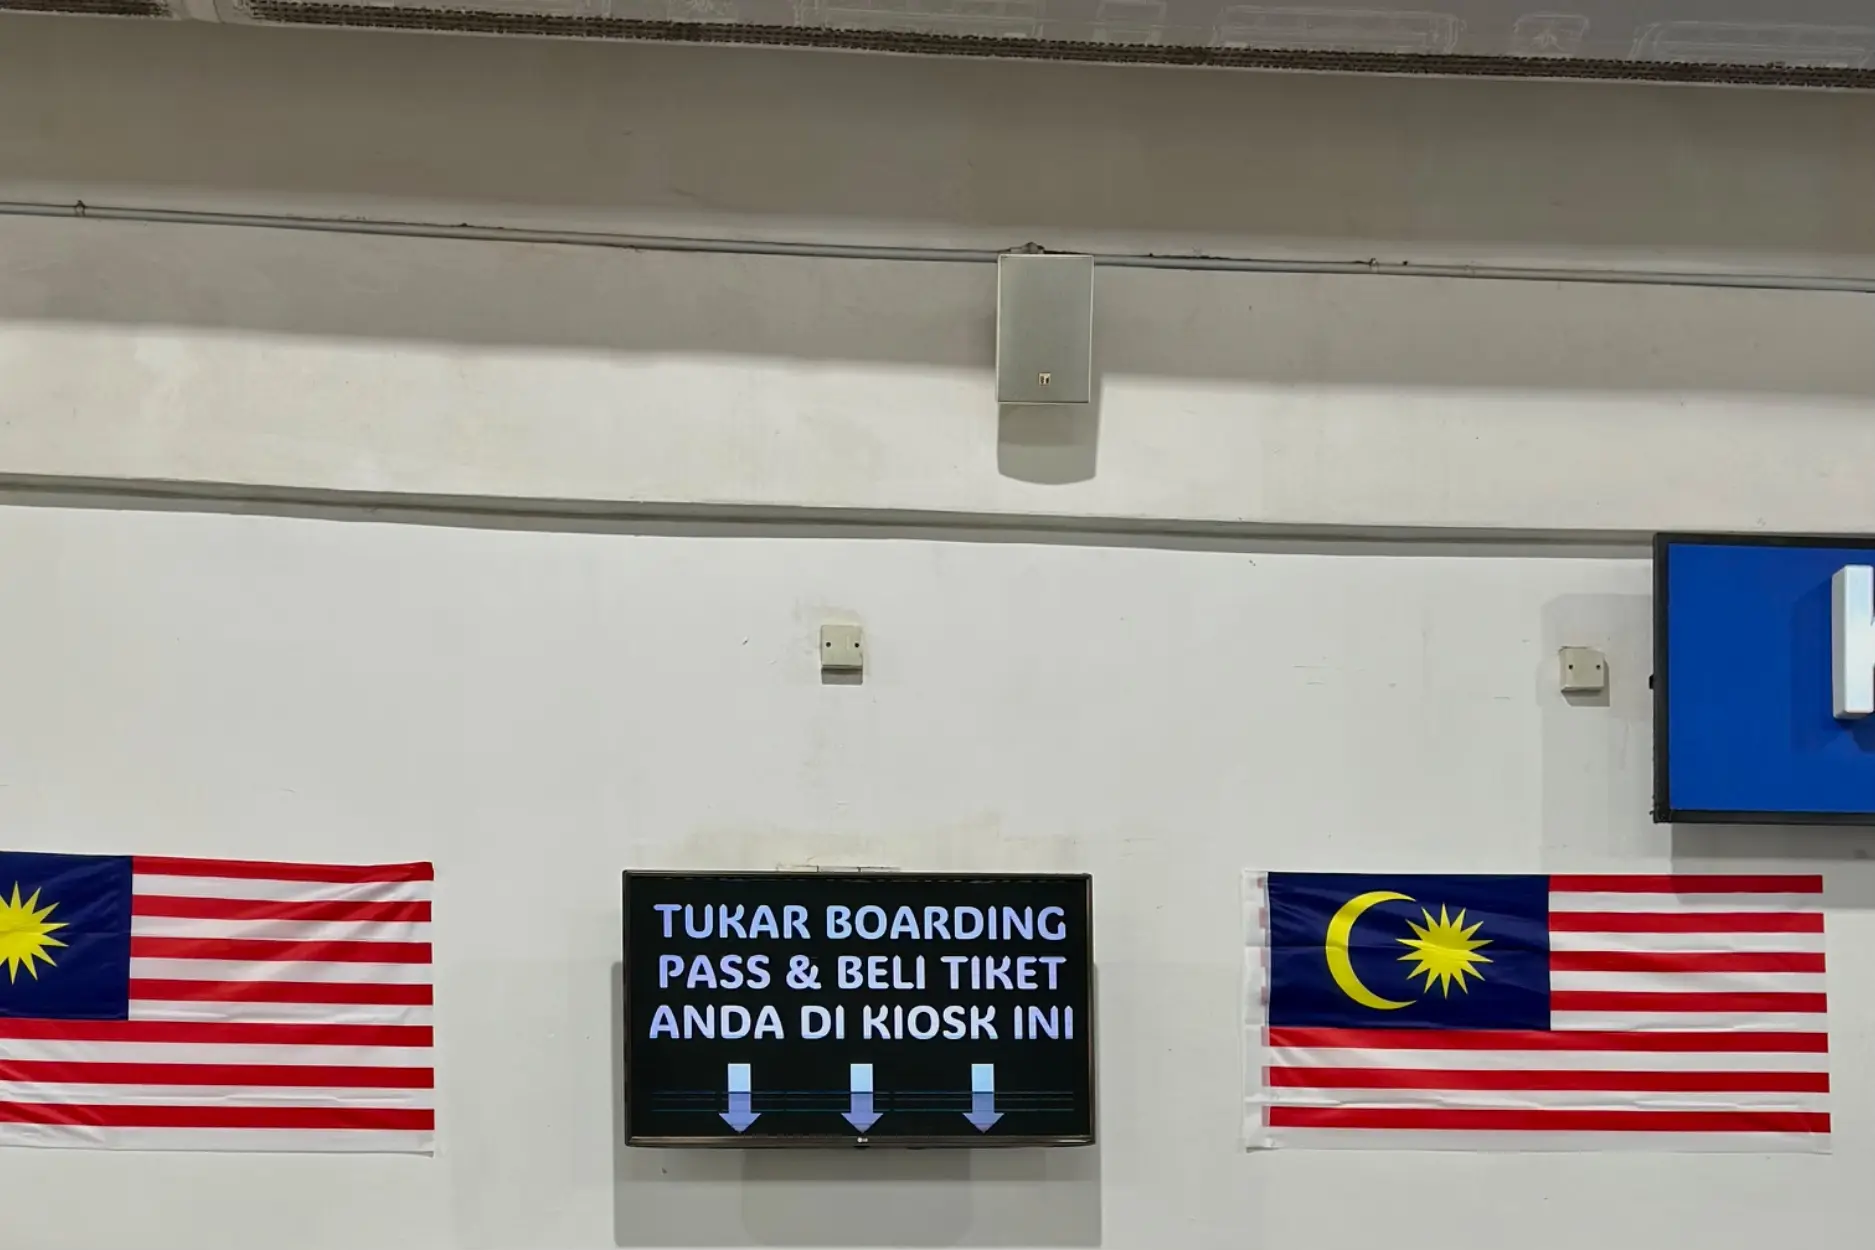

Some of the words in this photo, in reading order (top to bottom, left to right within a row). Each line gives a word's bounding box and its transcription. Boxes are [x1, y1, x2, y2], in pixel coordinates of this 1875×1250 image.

[653, 903, 811, 939] TUKAR
[826, 905, 1066, 940] BOARDING
[659, 954, 771, 989] PASS
[785, 955, 822, 990] &
[837, 955, 926, 990] BELI
[940, 955, 1067, 990] TIKET
[649, 1004, 785, 1040] ANDA
[800, 1004, 845, 1040] DI
[863, 1004, 999, 1040] KIOSK
[1013, 1004, 1074, 1041] INI
